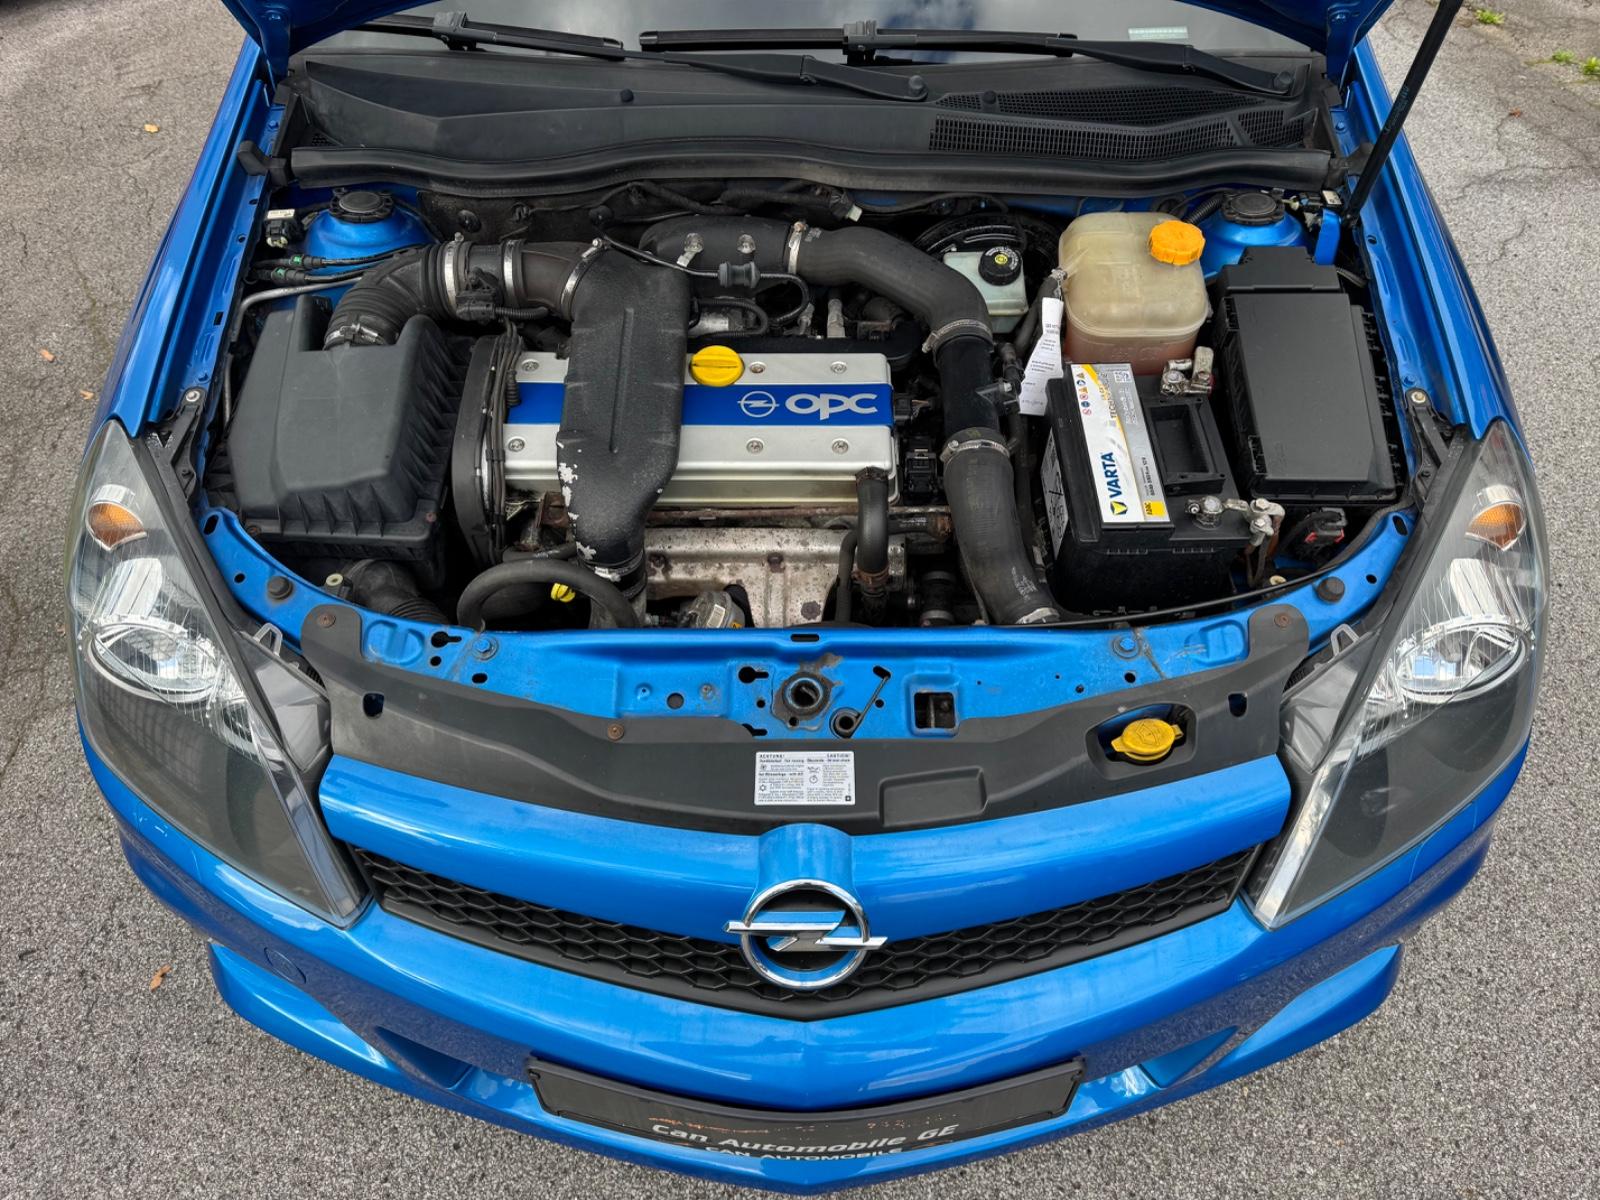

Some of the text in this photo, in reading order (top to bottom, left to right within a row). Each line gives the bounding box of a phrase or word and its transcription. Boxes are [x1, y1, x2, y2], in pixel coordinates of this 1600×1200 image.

[1100, 451, 1122, 498] VARTA
[652, 1123, 960, 1153] Can Automobile GE
